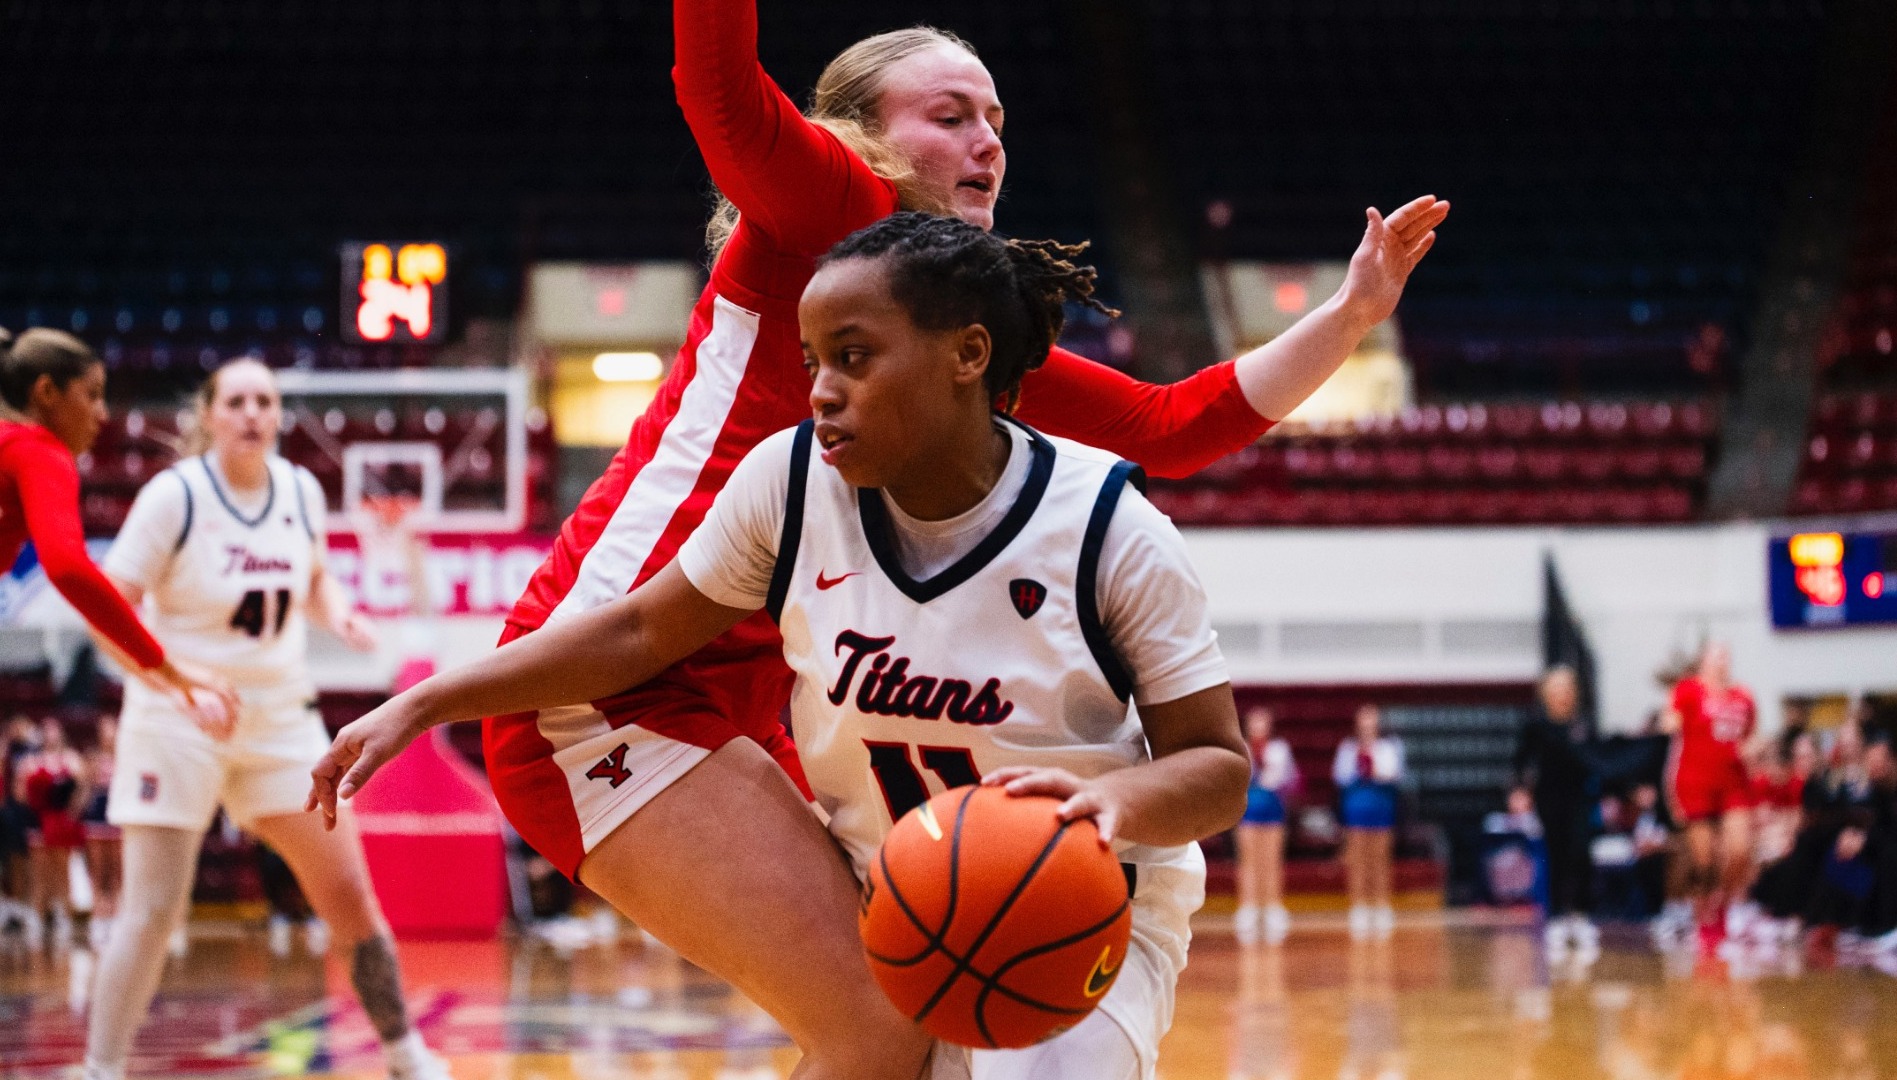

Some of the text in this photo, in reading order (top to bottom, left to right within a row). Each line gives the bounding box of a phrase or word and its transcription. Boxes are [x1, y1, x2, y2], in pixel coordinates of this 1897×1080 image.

[228, 588, 291, 638] 41
[827, 629, 1014, 726] Titans
[585, 742, 633, 789] Y
